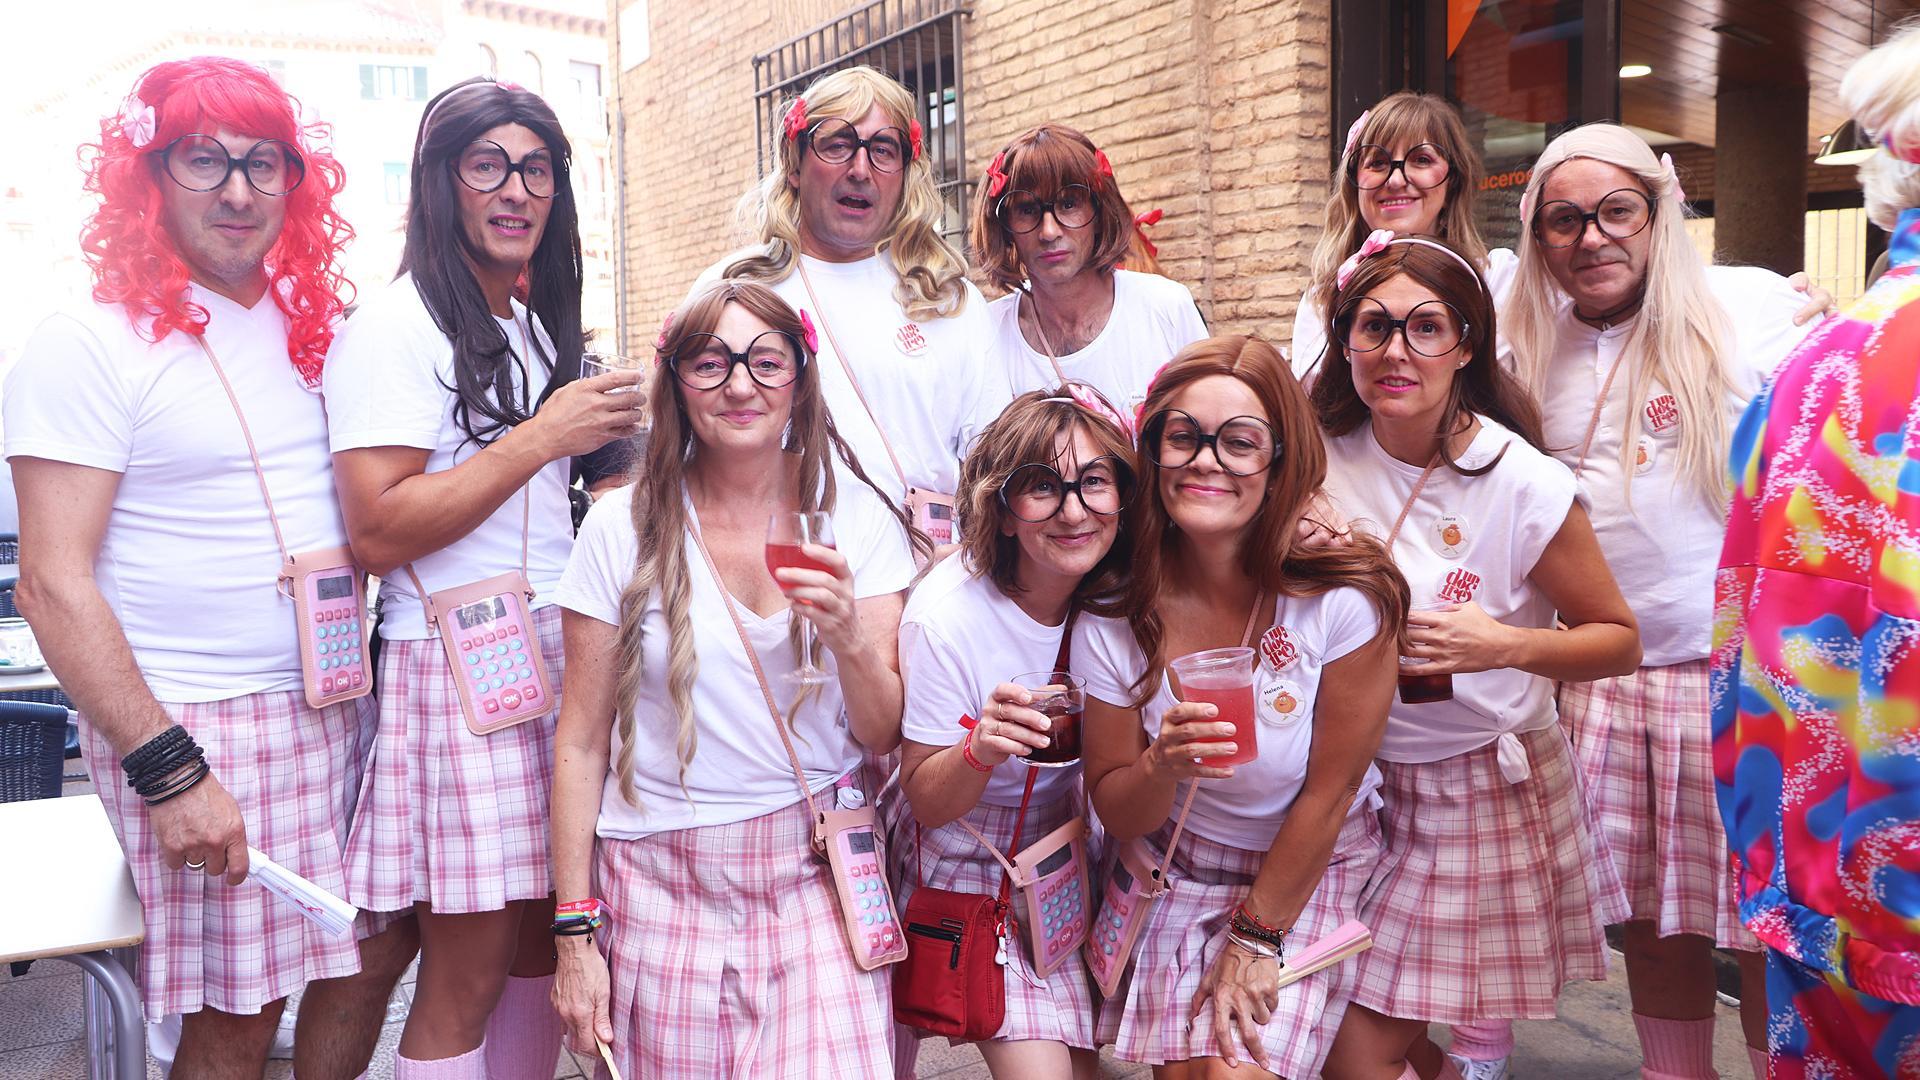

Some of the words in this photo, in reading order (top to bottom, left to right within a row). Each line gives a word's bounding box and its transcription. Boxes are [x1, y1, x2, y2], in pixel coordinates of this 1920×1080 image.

[336, 677, 349, 686] OK
[1263, 684, 1284, 695] Helena
[503, 693, 518, 704] OK
[884, 932, 894, 942] OK
[1061, 930, 1071, 942] OK
